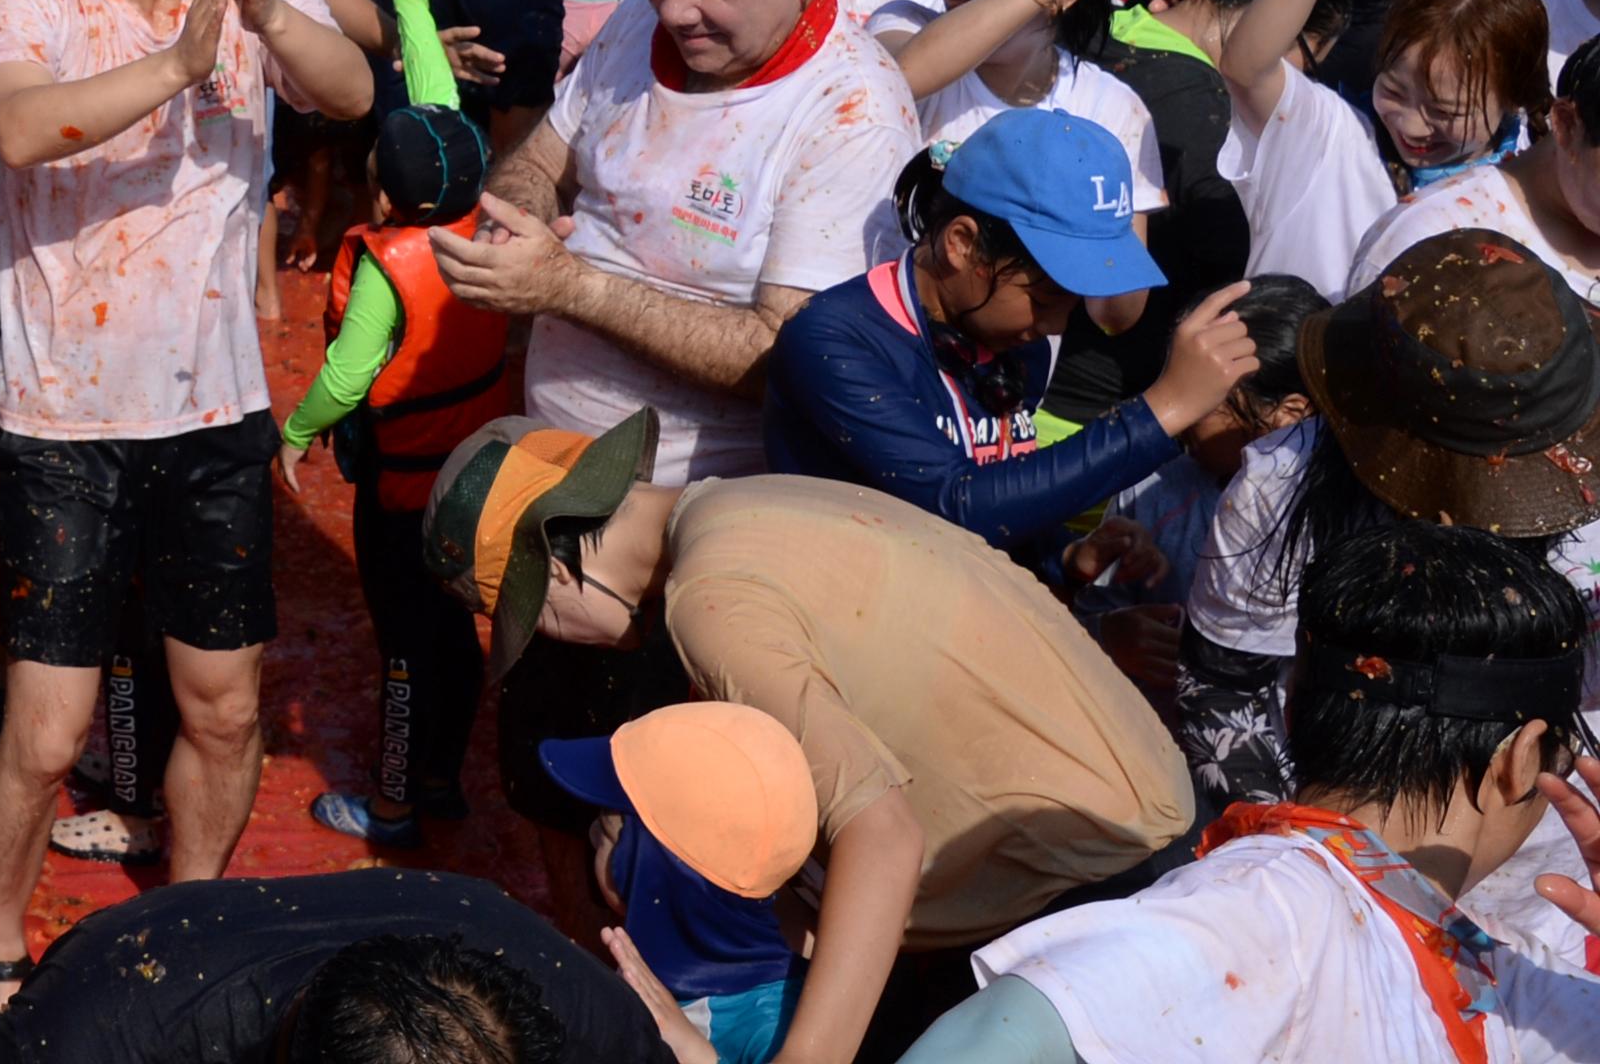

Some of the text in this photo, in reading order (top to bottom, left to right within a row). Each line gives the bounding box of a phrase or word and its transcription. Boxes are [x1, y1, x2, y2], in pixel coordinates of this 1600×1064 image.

[685, 179, 735, 216] 토마토
[1090, 176, 1131, 218] LA
[109, 676, 137, 802] PANCOAT
[382, 680, 411, 802] PANCOAT
